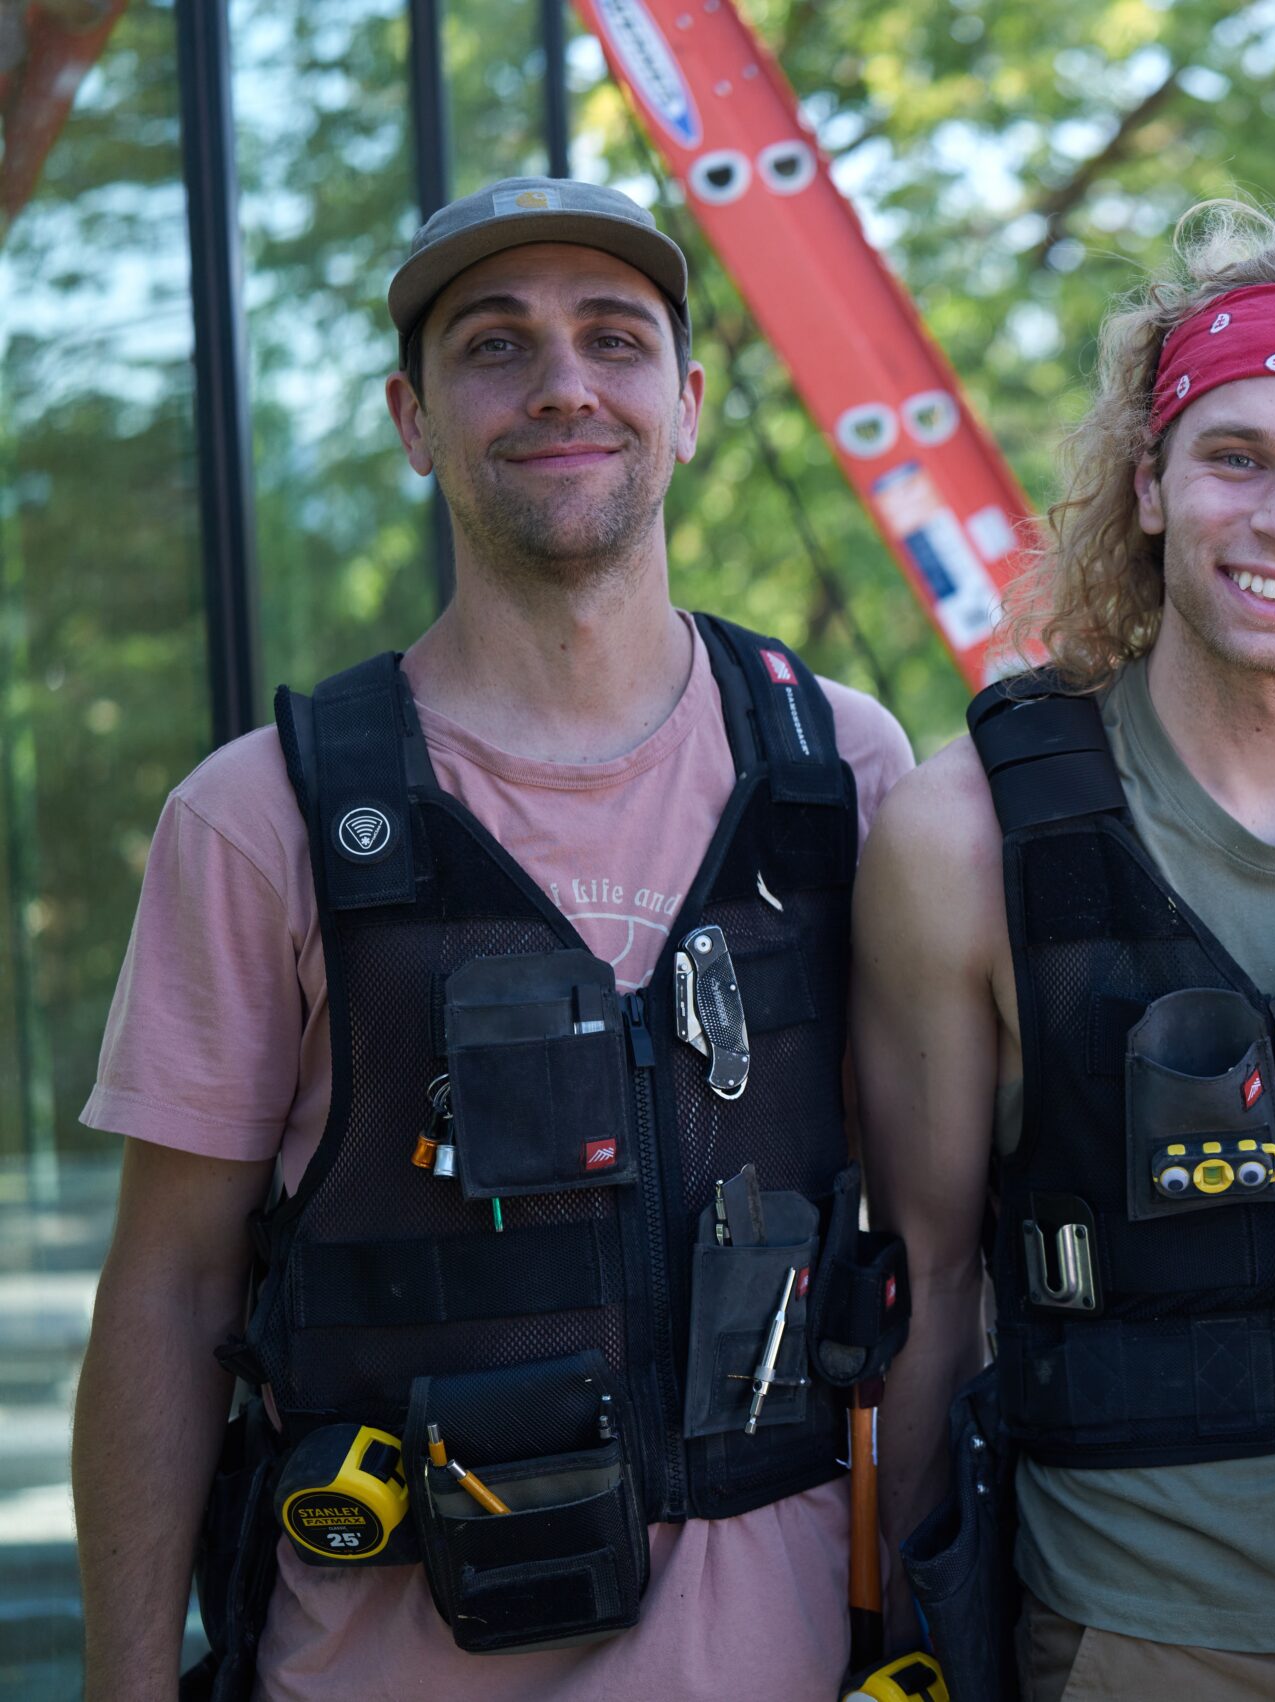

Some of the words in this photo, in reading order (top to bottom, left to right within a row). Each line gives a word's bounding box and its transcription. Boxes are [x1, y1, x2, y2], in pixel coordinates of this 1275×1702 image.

[571, 878, 624, 904] Life
[633, 887, 683, 916] and
[298, 1506, 360, 1518] STANLEY
[306, 1517, 362, 1526] FATMAX
[326, 1532, 363, 1548] 25'
